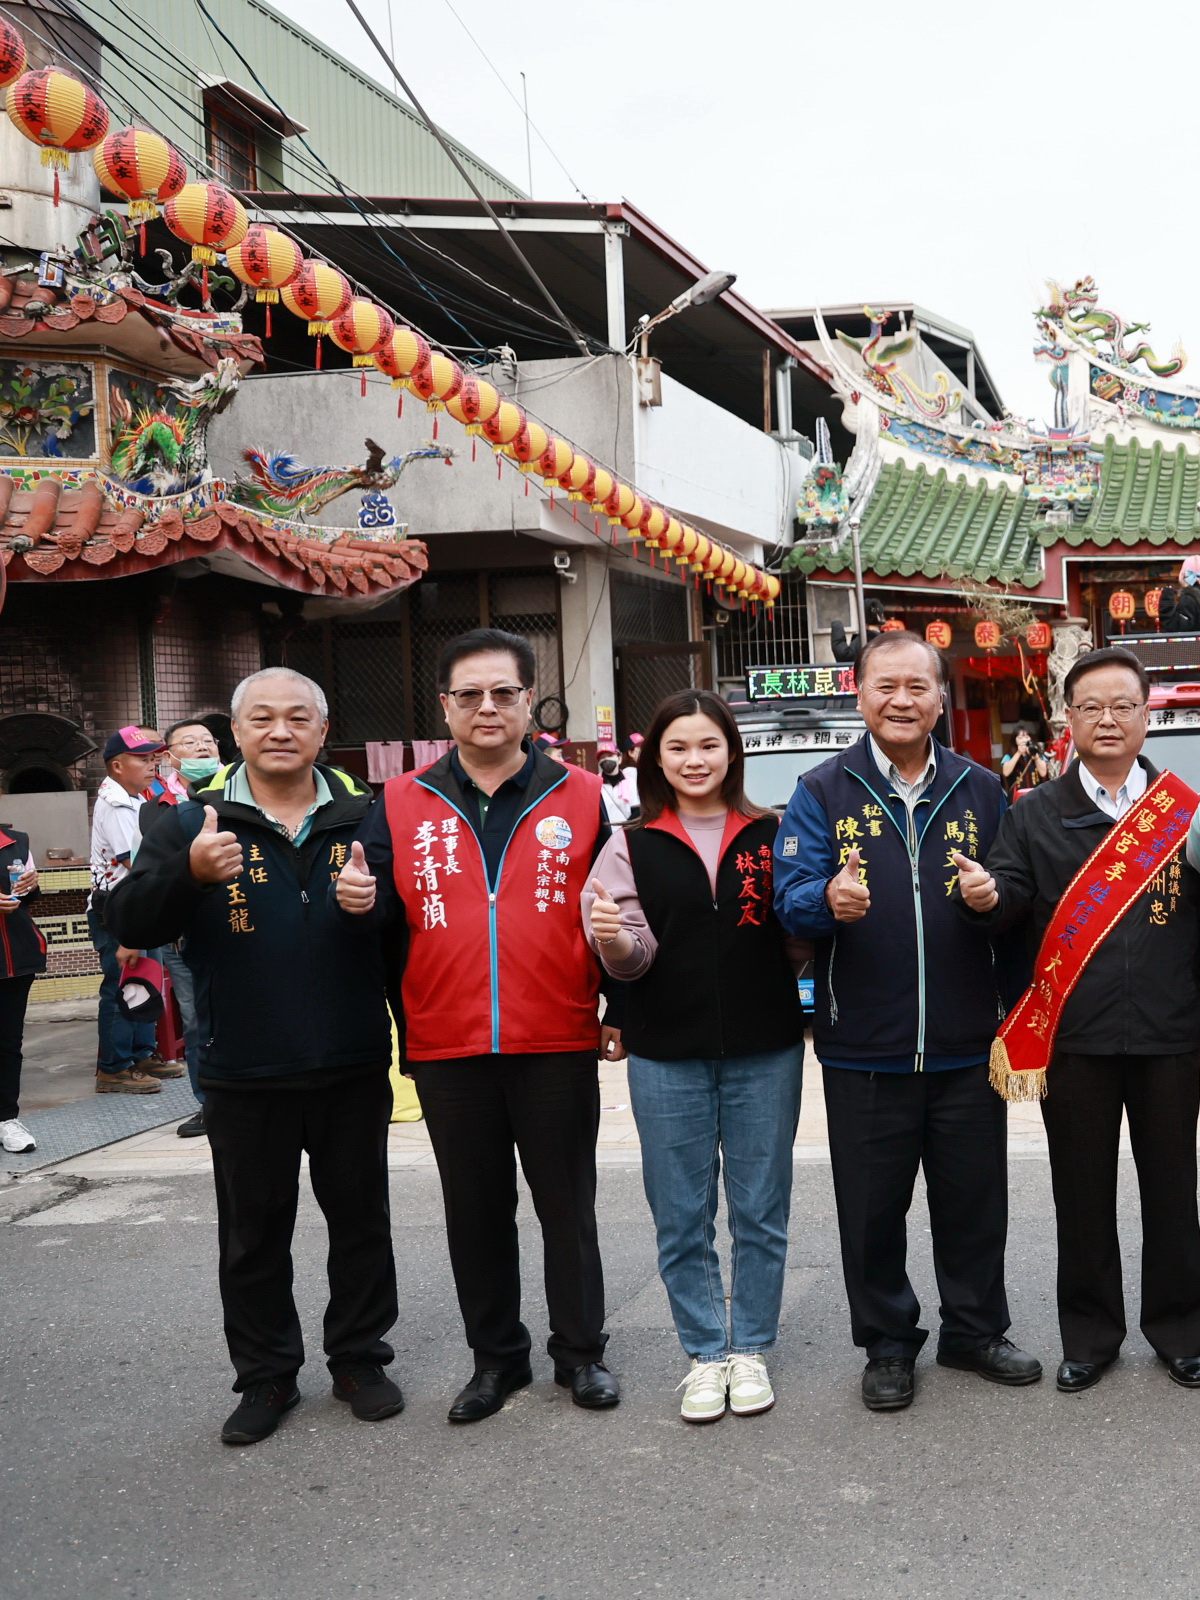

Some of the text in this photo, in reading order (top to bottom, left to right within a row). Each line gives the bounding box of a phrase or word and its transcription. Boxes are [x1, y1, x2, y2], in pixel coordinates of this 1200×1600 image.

[441, 816, 463, 876] 理事長
[861, 803, 883, 837] 秘書
[963, 808, 979, 859] 立法委員
[249, 843, 270, 884] 主任
[534, 849, 553, 913] 李氏宗親會
[552, 850, 571, 905] 南投縣
[735, 850, 763, 927] 林友友
[226, 875, 255, 933] 玉龍
